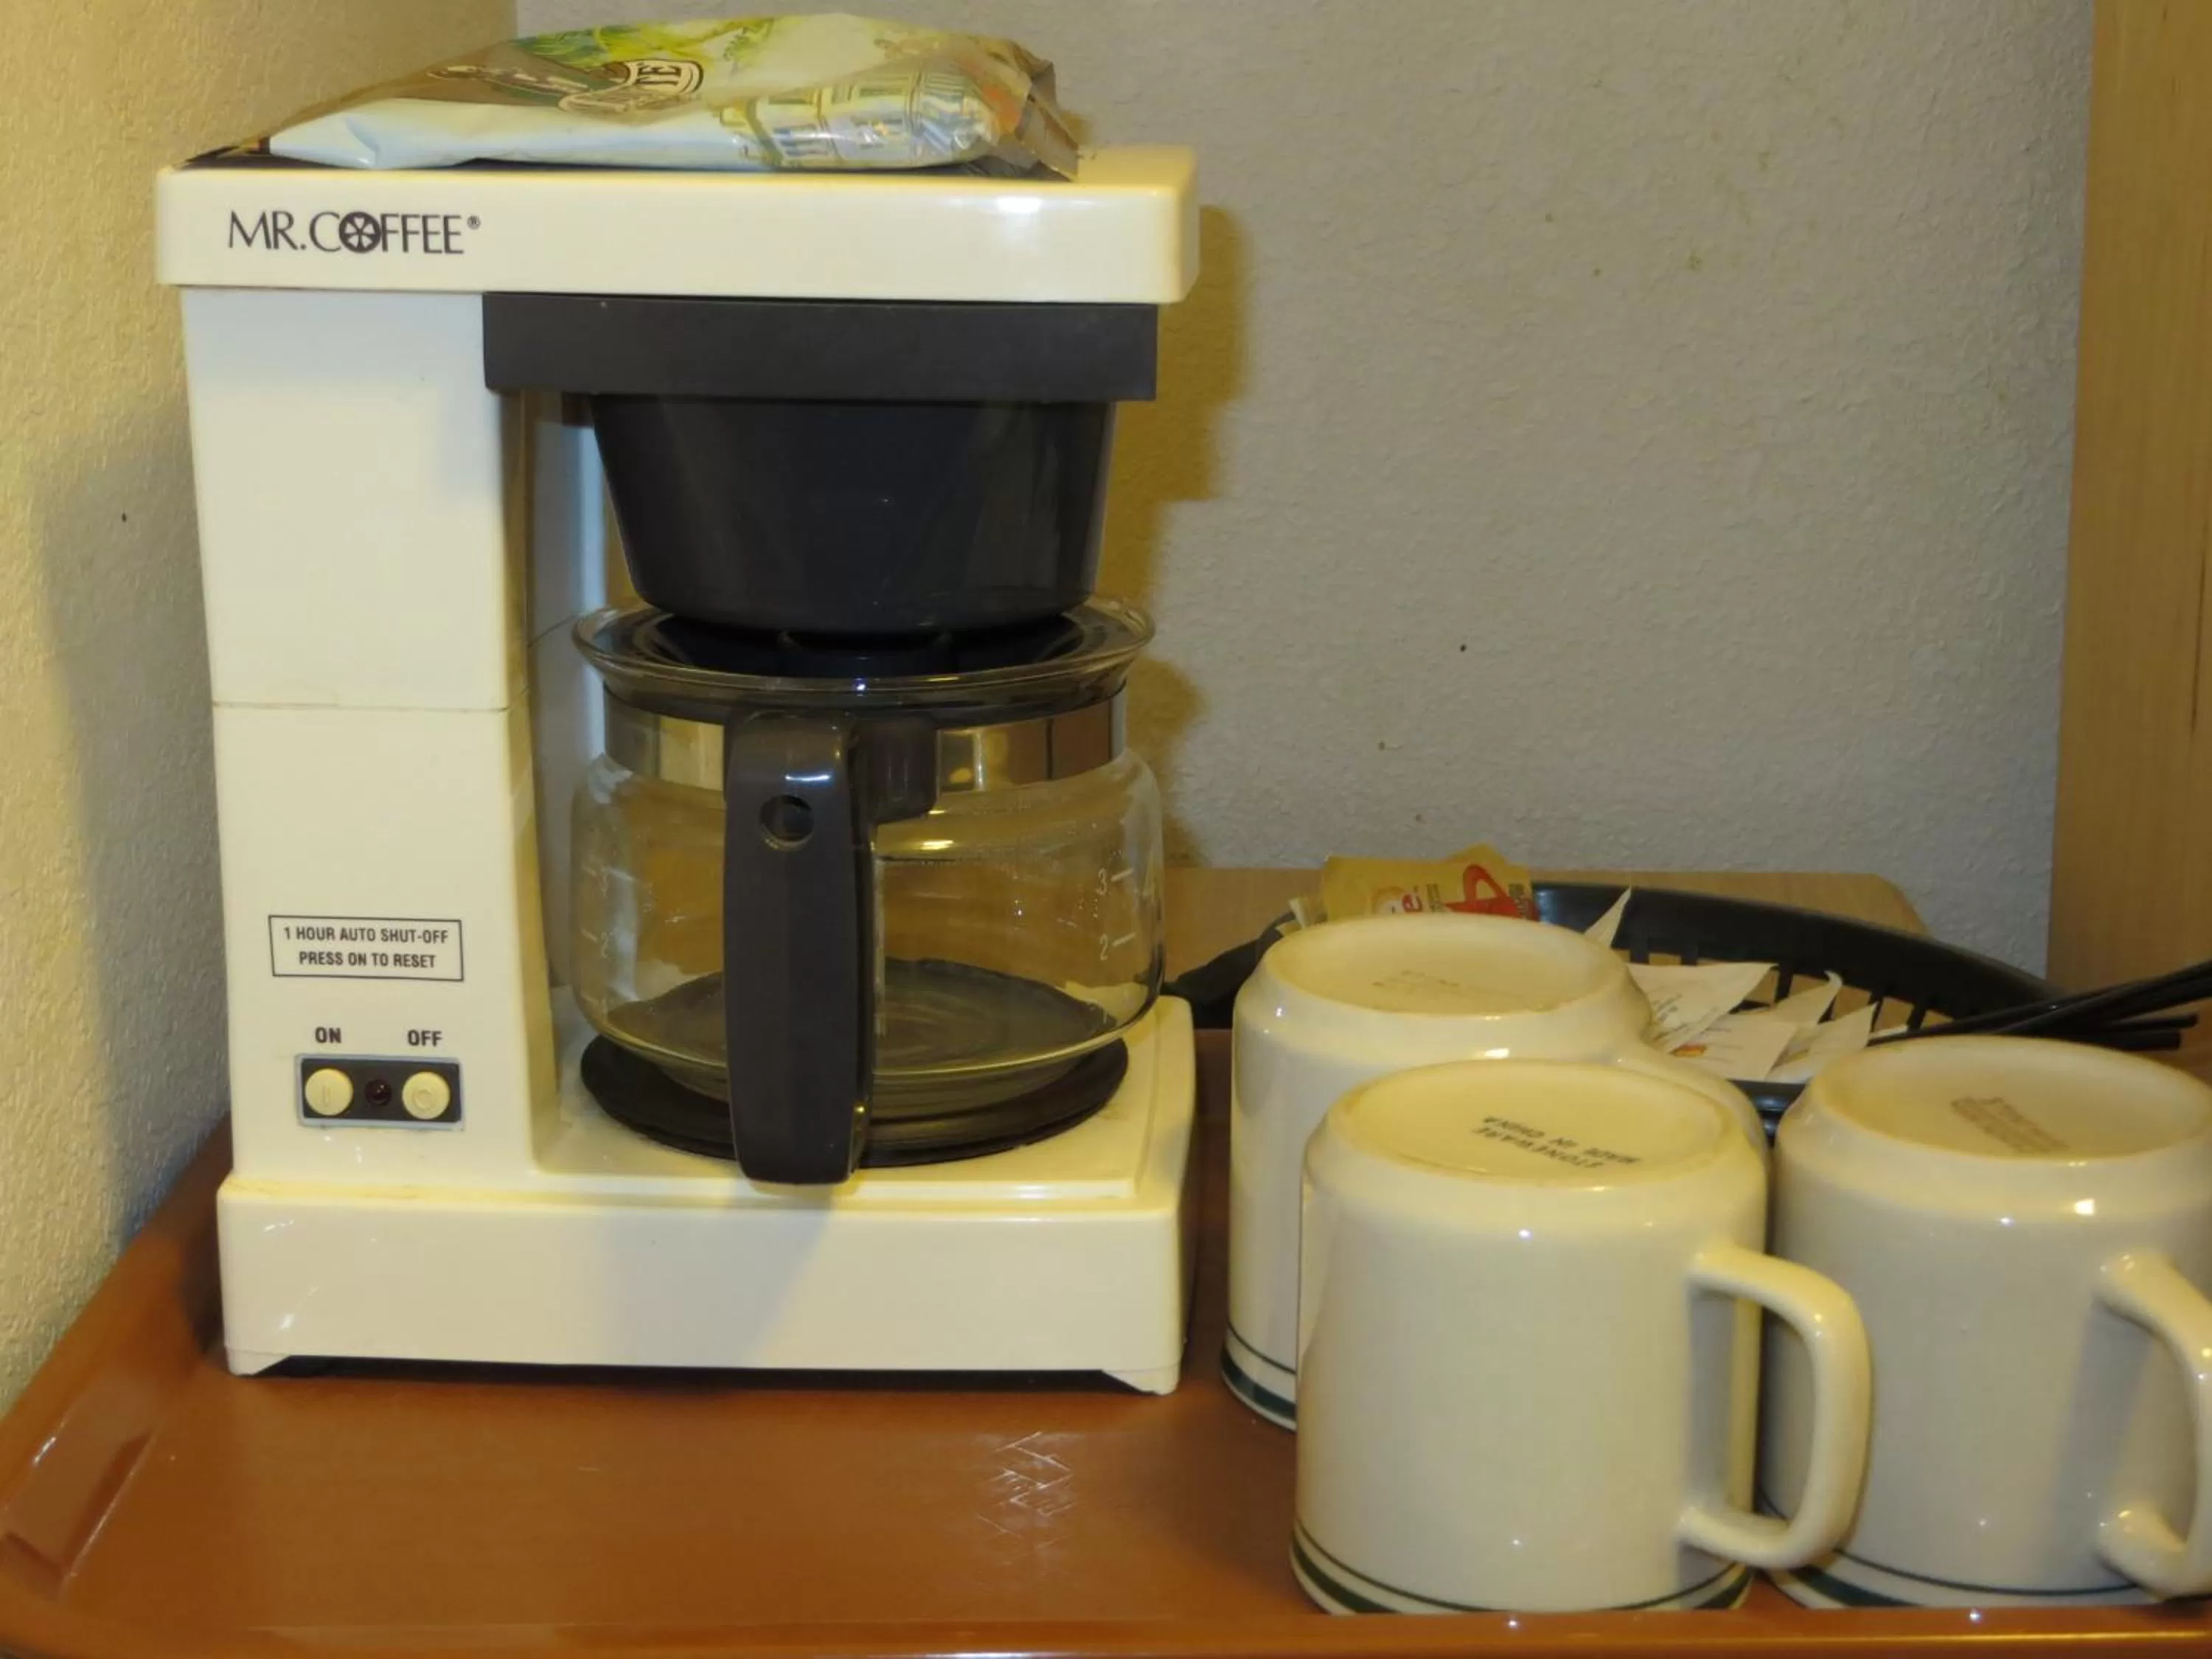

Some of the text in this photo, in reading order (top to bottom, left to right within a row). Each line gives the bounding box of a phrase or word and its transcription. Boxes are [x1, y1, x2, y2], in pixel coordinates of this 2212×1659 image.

[1096, 869, 1107, 895] 3
[284, 927, 449, 944] 1 HOUR AUTO SHUT-OFF
[1099, 933, 1109, 961] 2
[299, 951, 437, 968] PRESS ON TO RESET
[314, 1026, 342, 1044] ON
[407, 1029, 443, 1047] OFF
